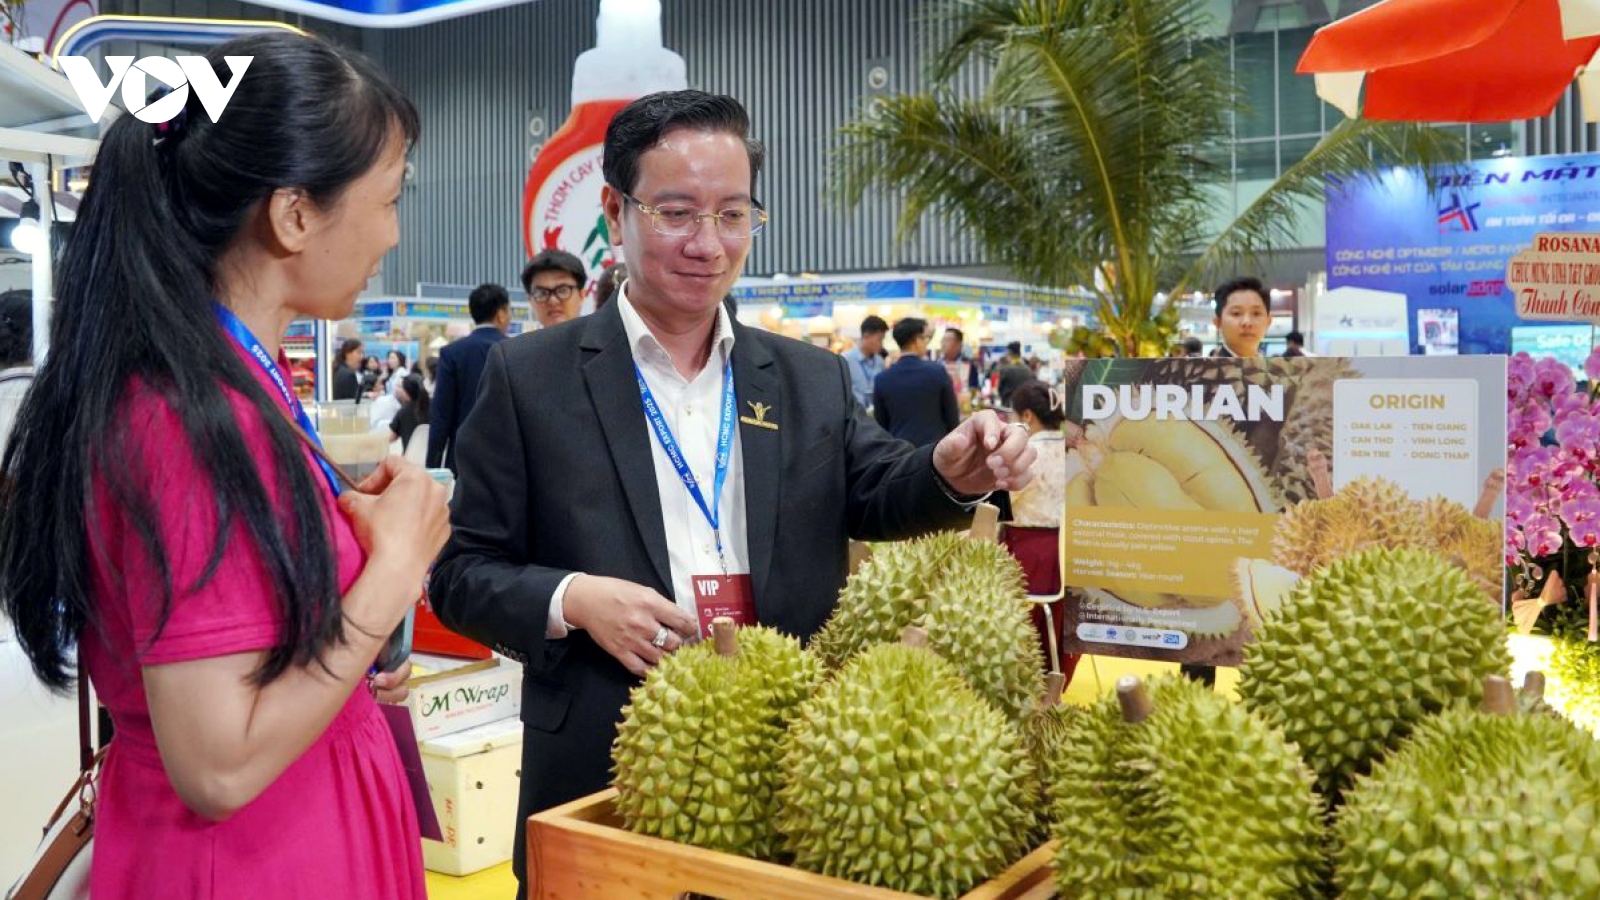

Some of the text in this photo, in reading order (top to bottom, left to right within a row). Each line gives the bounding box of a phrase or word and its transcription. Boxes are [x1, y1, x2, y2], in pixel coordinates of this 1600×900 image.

[569, 159, 594, 183] CAY
[1538, 237, 1600, 253] ROSANA
[1522, 288, 1568, 315] Thành
[645, 398, 658, 416] 2025
[724, 393, 733, 423] EXPORT
[1082, 384, 1284, 421] DURIAN
[1369, 394, 1446, 409] ORIGIN
[654, 416, 671, 445] EXPORT
[1412, 423, 1433, 431] TIEN
[1411, 437, 1466, 446] VINH LONG
[697, 580, 719, 596] VIP
[422, 691, 450, 717] M
[455, 683, 509, 704] Wrap
